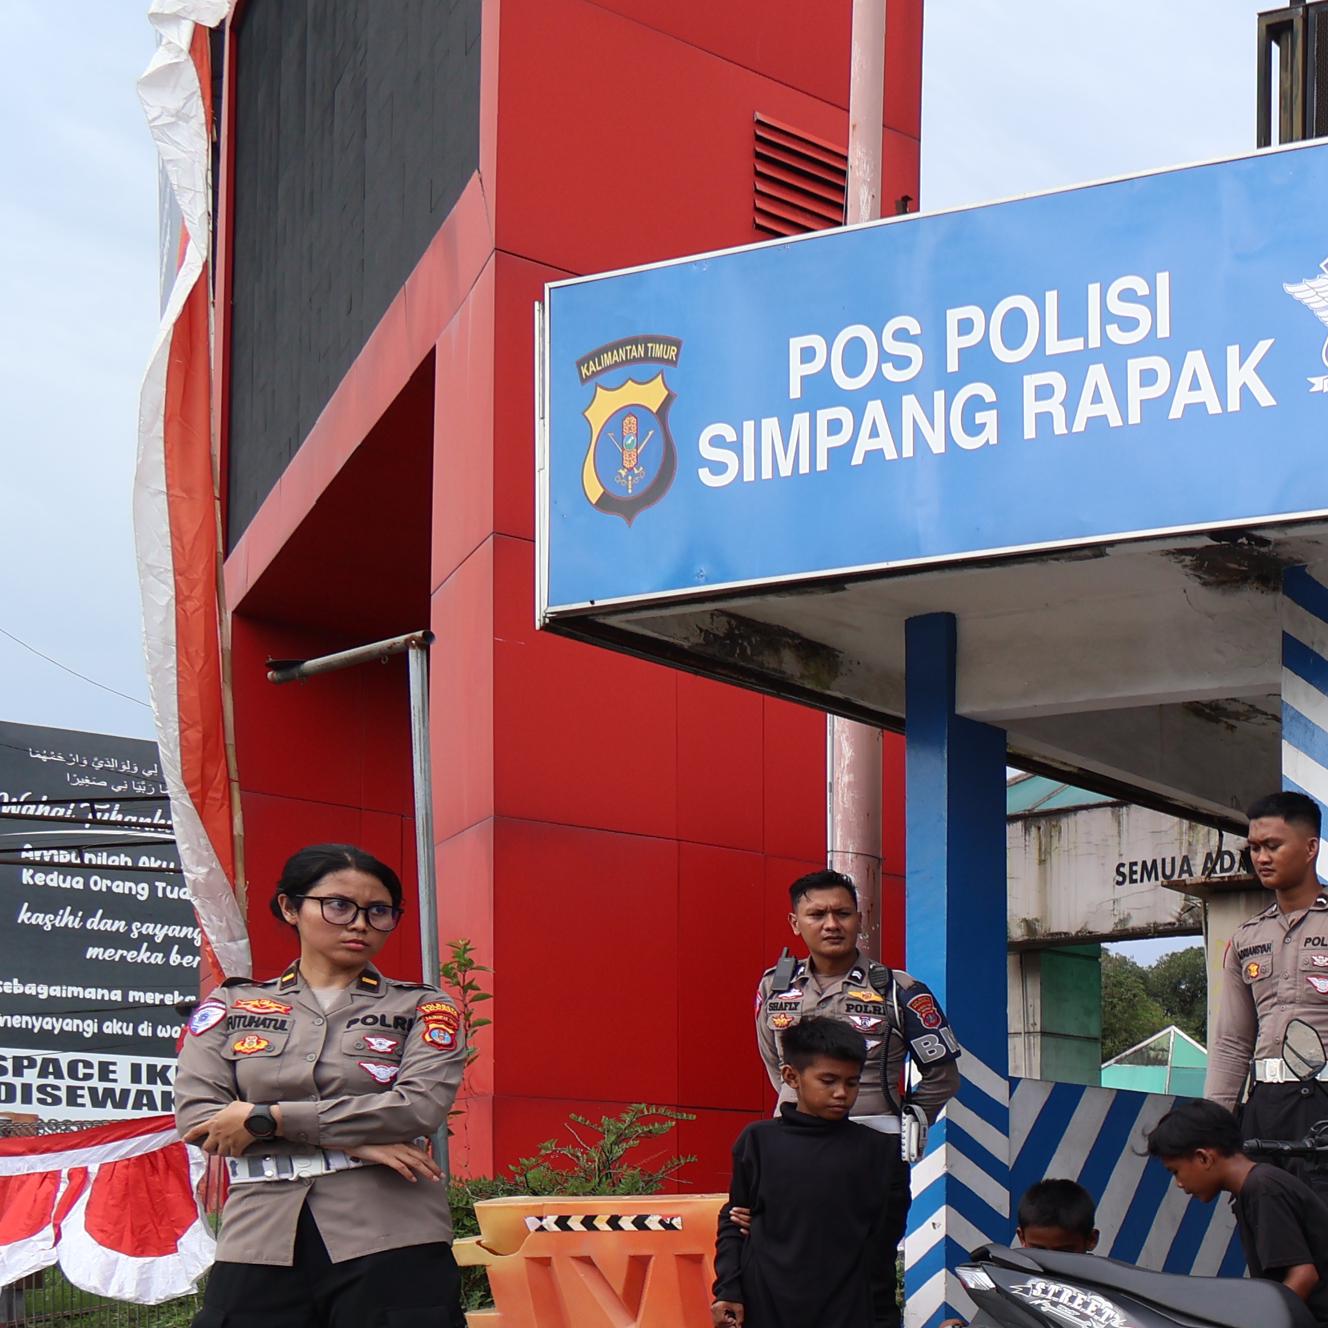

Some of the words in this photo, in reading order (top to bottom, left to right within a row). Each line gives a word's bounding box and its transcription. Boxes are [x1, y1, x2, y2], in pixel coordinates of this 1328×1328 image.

[789, 314, 923, 399] POS
[946, 270, 1170, 373] POLISI
[581, 343, 645, 379] KALIMANTAN
[647, 343, 678, 361] TIMUR
[698, 382, 998, 488] SIMPANG
[1023, 338, 1276, 440] RAPAK
[22, 868, 84, 890] Kedua
[90, 875, 149, 900] Orang
[1115, 855, 1194, 886] SEMUA
[17, 902, 83, 931] kasihi
[86, 909, 128, 933] dan
[86, 942, 166, 966] mereka
[129, 989, 196, 1005] mereka
[768, 1001, 800, 1012] SHAFLY
[103, 1018, 133, 1035] aku
[138, 1021, 152, 1037] di
[131, 1063, 178, 1086] IK
[1031, 1281, 1119, 1323] STREET
